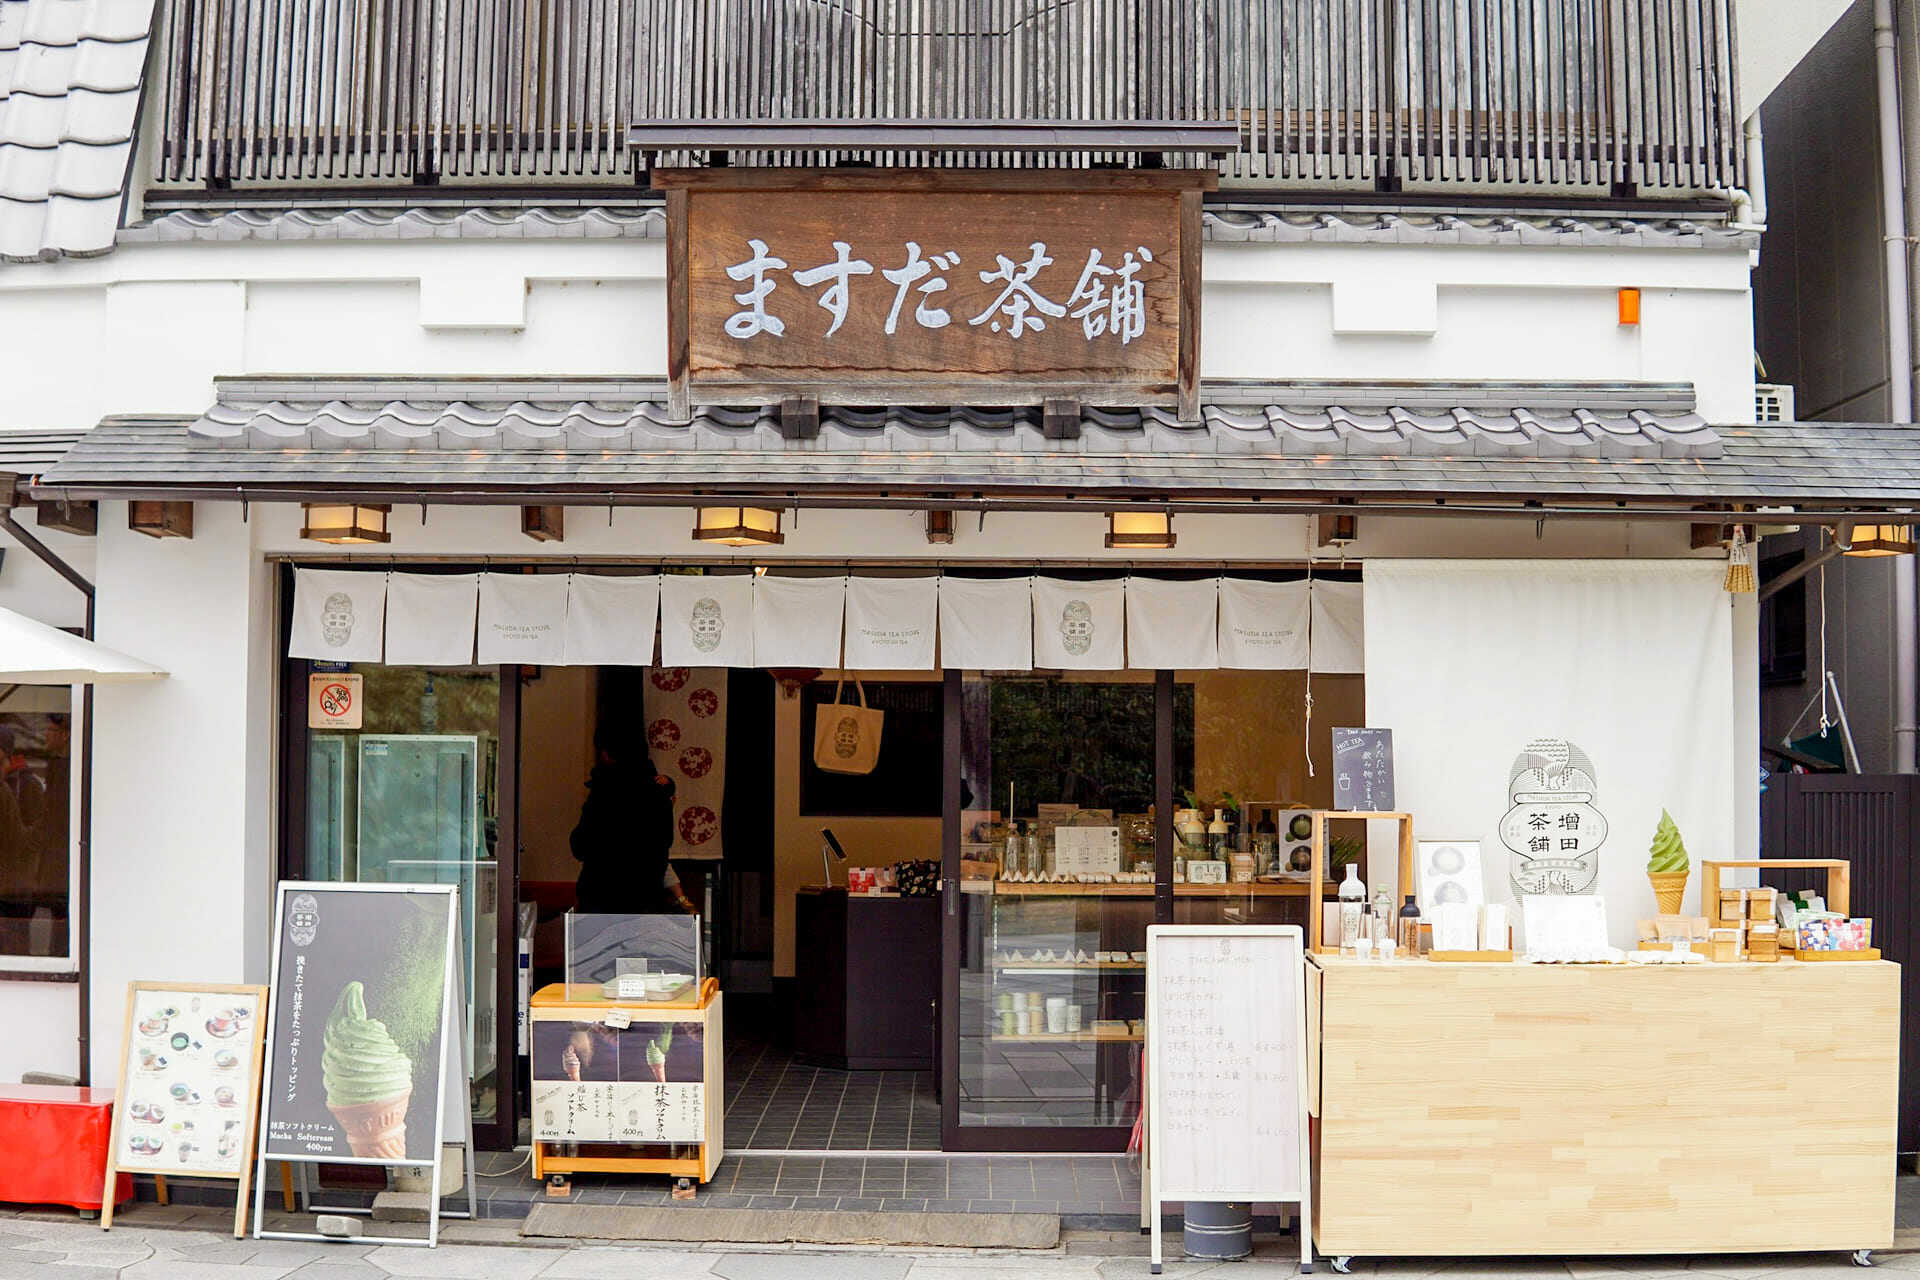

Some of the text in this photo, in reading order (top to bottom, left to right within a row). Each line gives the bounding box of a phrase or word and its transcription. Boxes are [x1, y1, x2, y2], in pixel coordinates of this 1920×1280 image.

[724, 238, 1153, 346] ますだ茶舗
